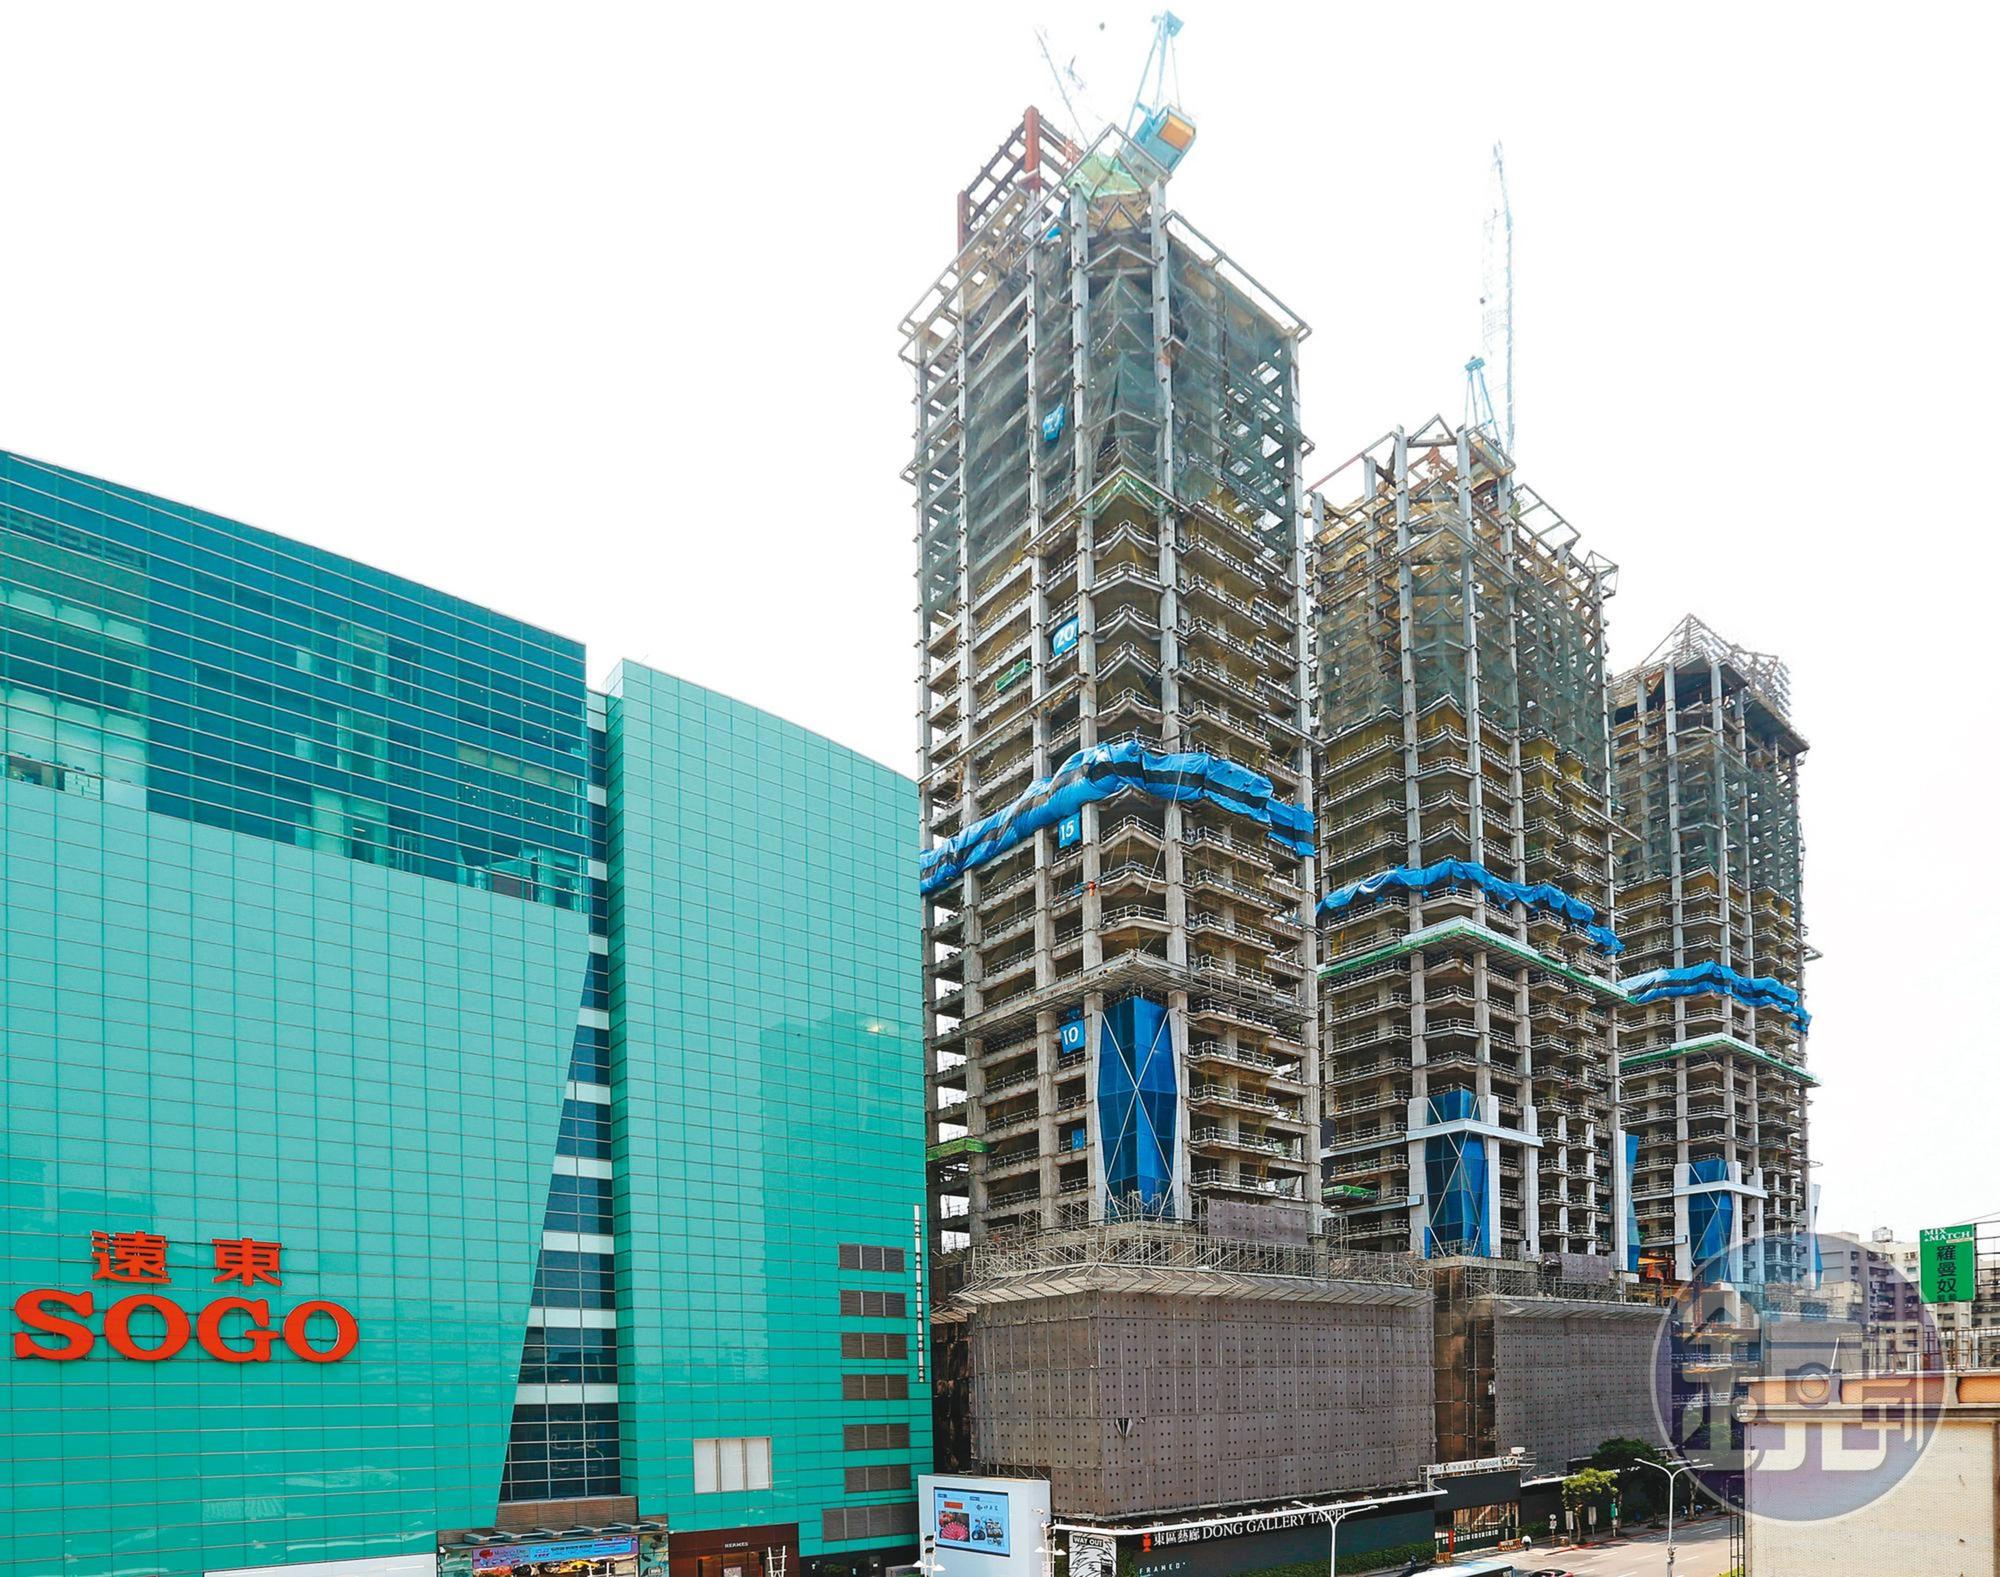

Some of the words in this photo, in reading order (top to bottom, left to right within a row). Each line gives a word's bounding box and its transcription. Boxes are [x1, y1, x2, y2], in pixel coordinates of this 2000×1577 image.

[1057, 624, 1075, 648] 20
[1060, 820, 1075, 840] 15
[1063, 1026, 1079, 1045] 10
[1924, 1228, 1947, 1236] MIX
[90, 1230, 283, 1287] 遠東
[14, 1288, 359, 1362] SOGO
[1203, 1522, 1243, 1540] DONG
[1246, 1514, 1306, 1533] GALLERY
[1073, 1536, 1088, 1544] WAY
